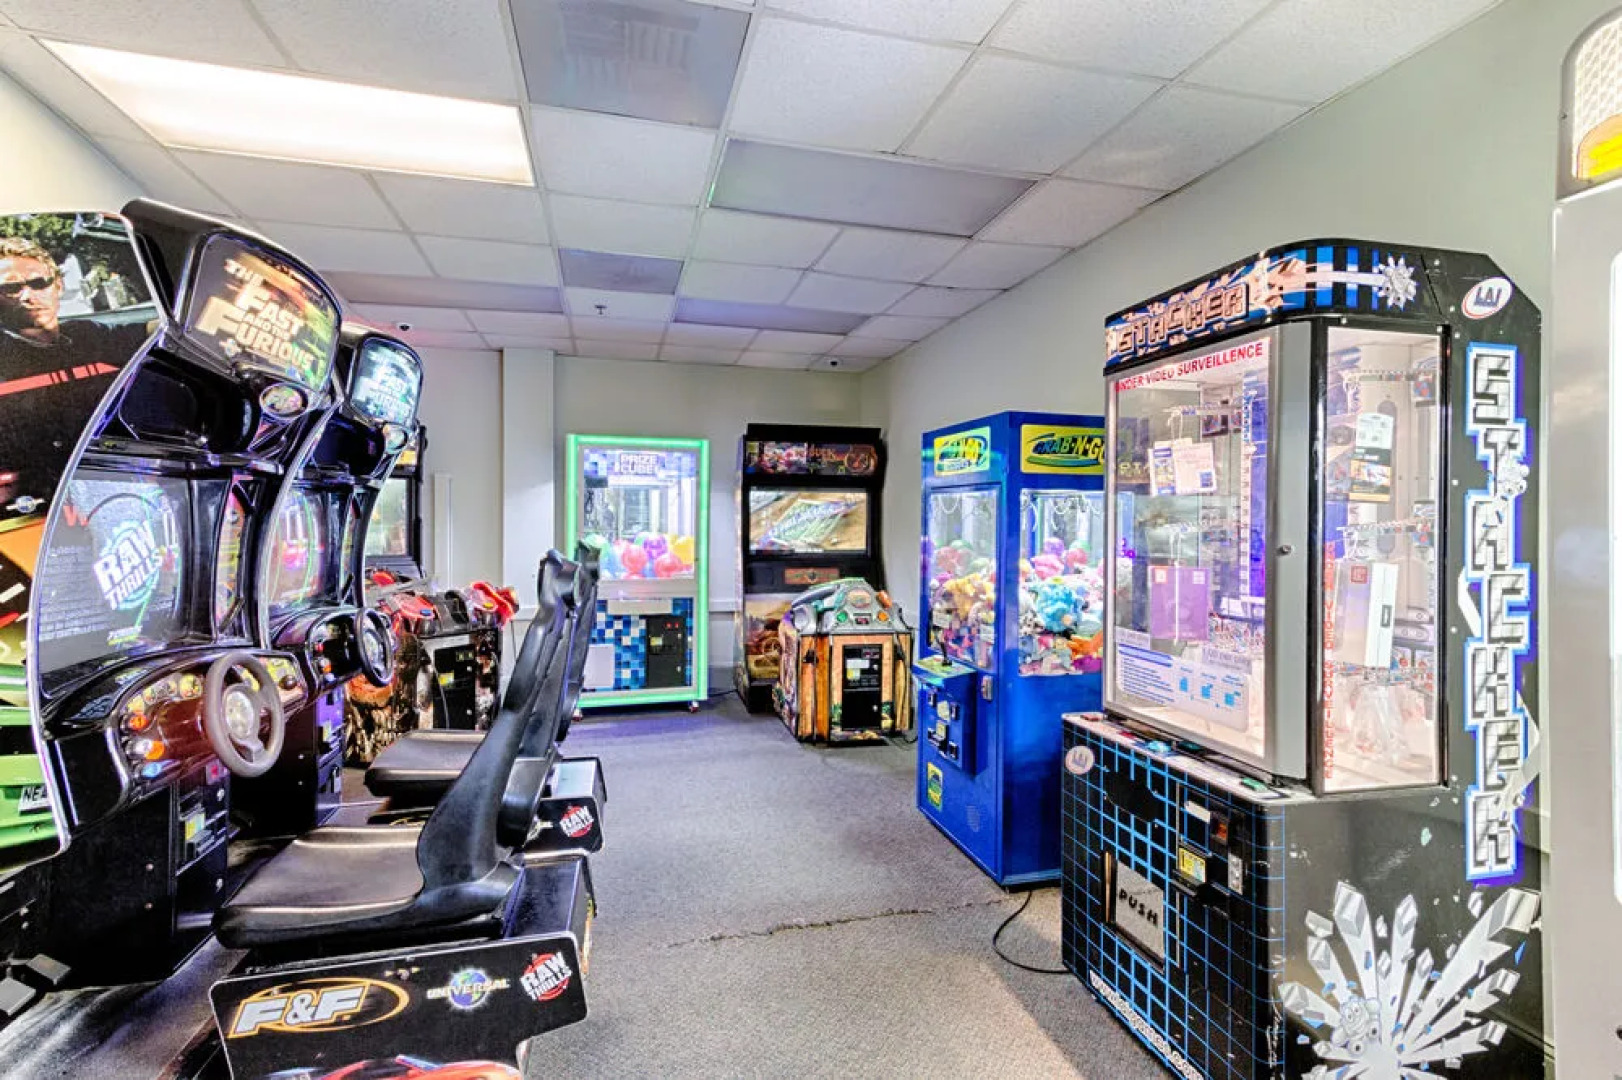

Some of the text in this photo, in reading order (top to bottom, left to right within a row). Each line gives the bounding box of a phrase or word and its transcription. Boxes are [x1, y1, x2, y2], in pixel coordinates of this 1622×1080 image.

[195, 296, 315, 371] FURIOUS
[236, 282, 304, 335] FAST
[1116, 285, 1244, 353] STACKER
[1177, 342, 1264, 376] SURVEILLENCE
[93, 520, 155, 596] RAW
[104, 547, 164, 610] THRILLS
[1469, 347, 1527, 872] STACKER
[1118, 888, 1159, 926] PUSH
[520, 952, 568, 993] RAW
[231, 982, 367, 1036] F&F
